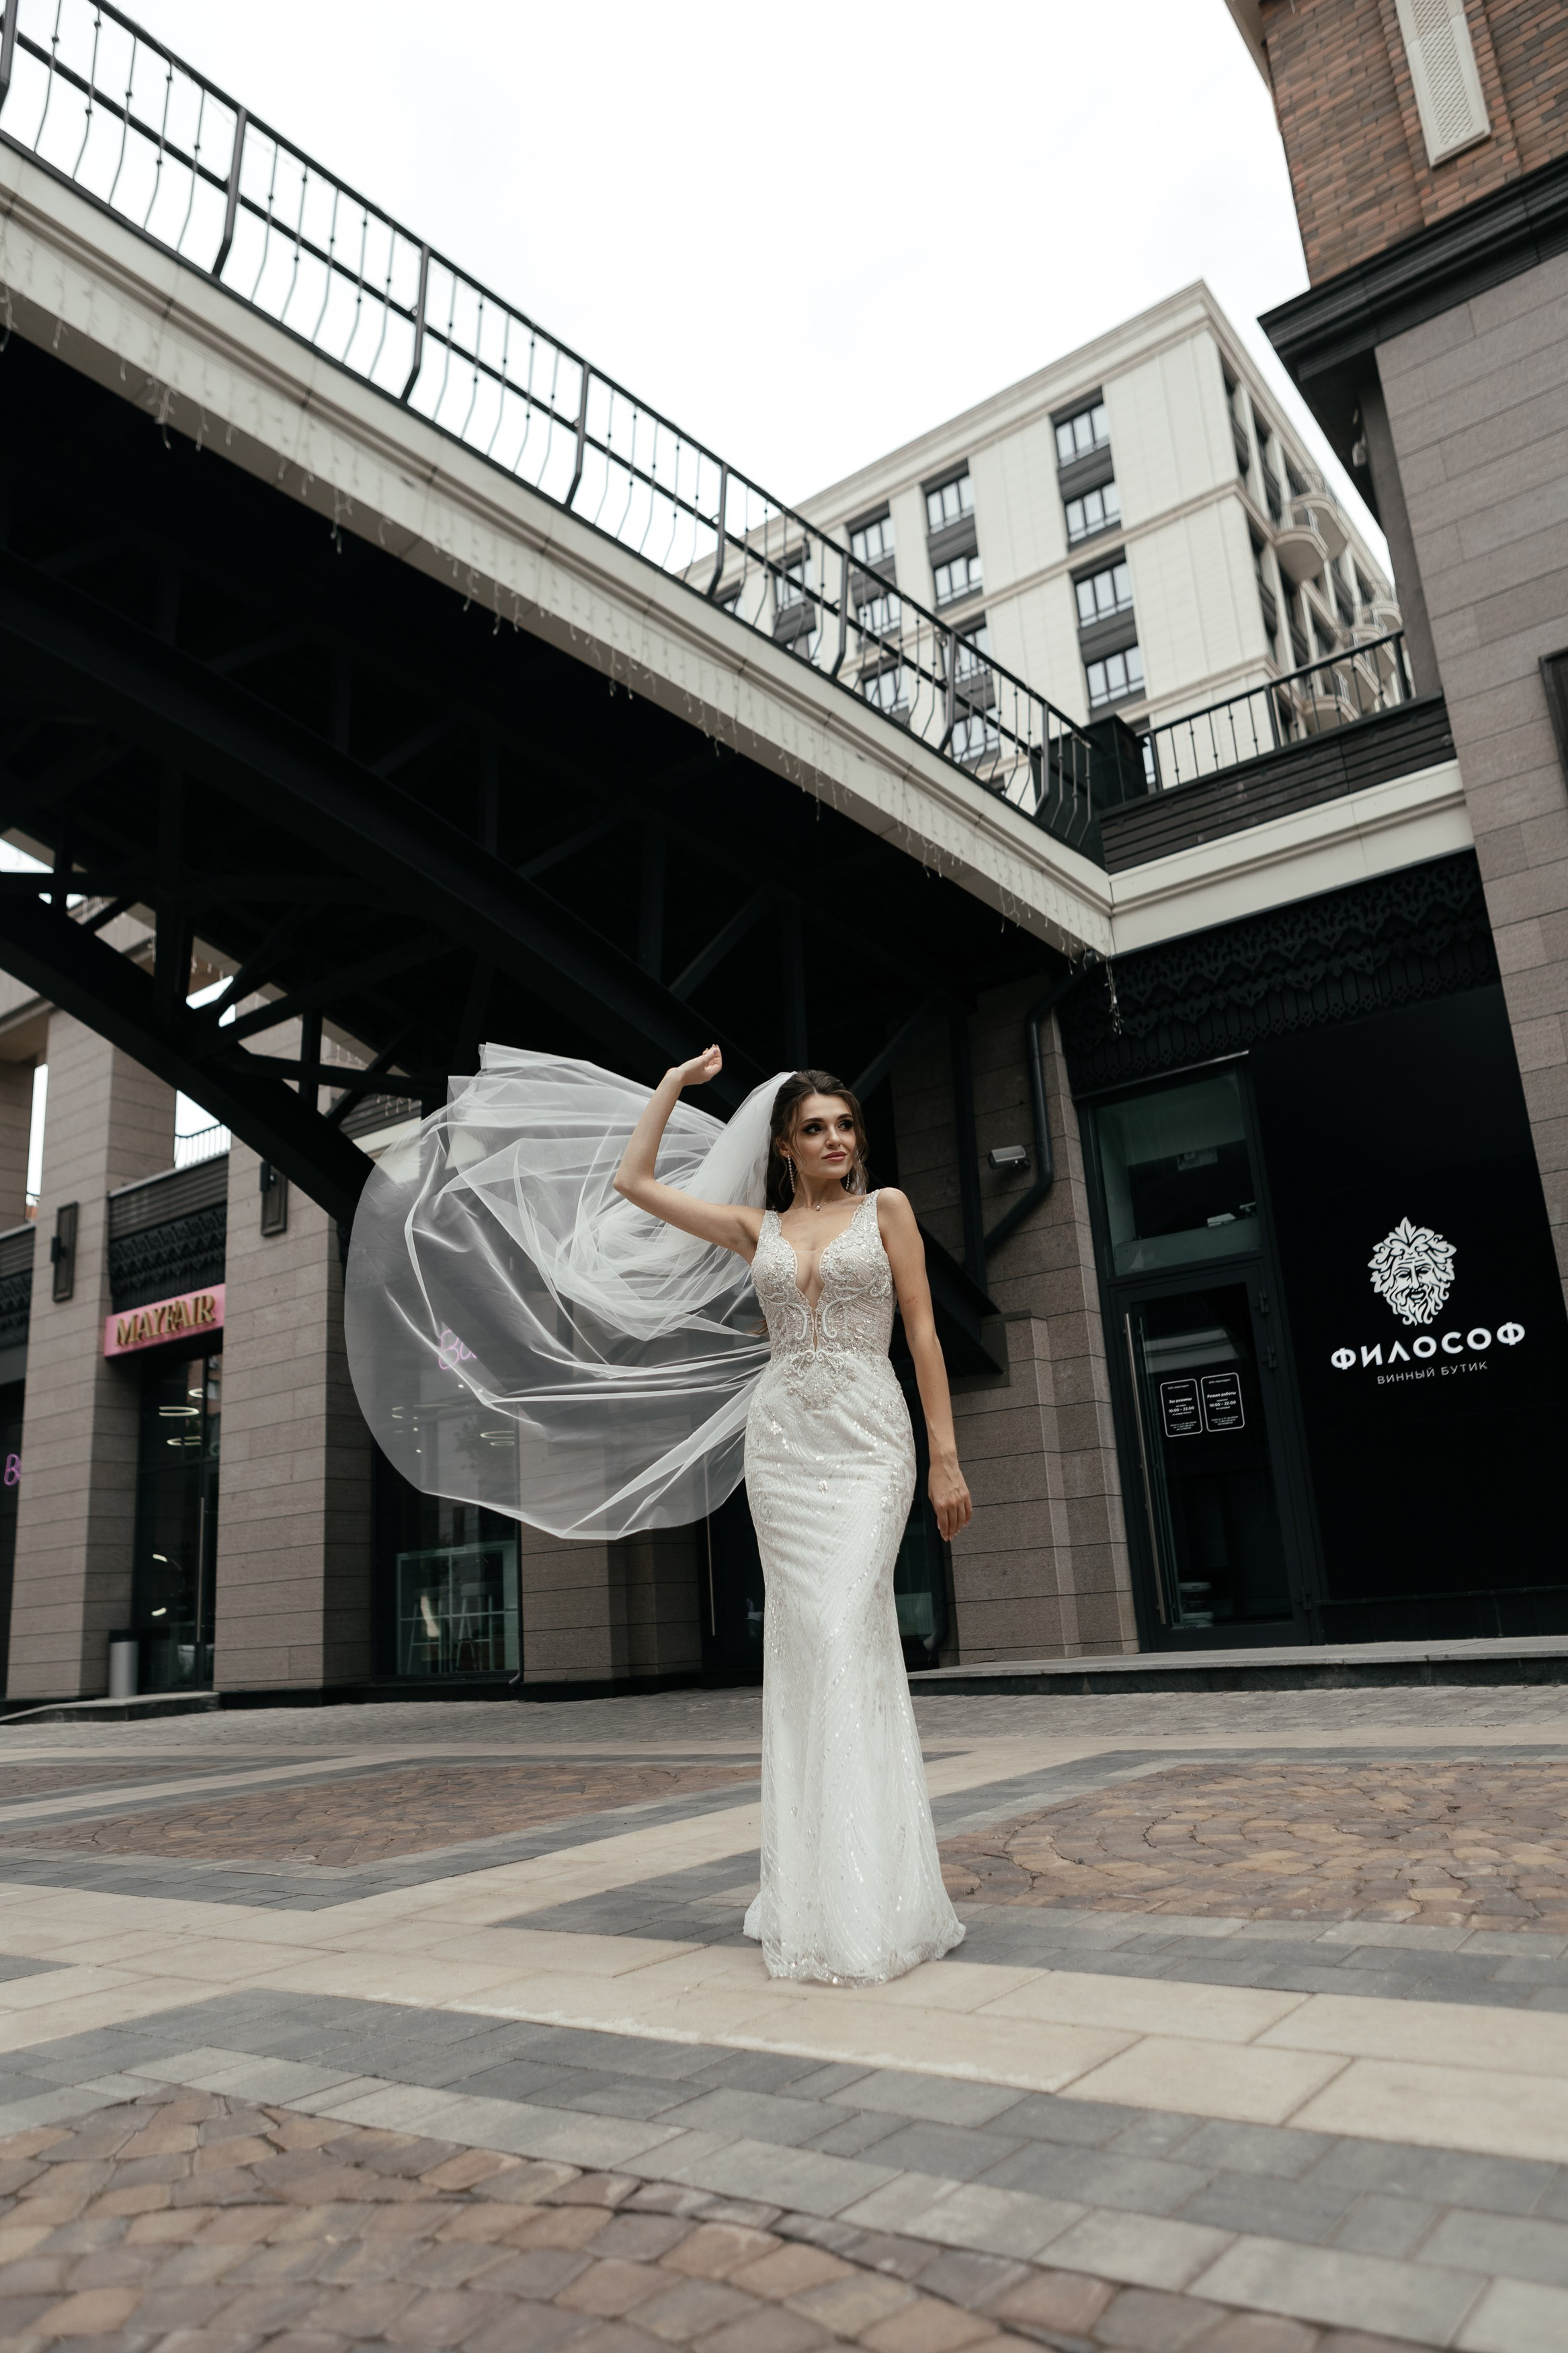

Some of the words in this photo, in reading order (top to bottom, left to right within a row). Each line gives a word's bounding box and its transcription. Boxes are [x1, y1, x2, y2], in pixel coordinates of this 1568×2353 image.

[114, 1294, 216, 1347] MAYFAIR
[1331, 1321, 1526, 1370] ФИЛОСОФ
[1377, 1367, 1435, 1385] ВИННЫЙ
[1441, 1361, 1488, 1376] БУТИК
